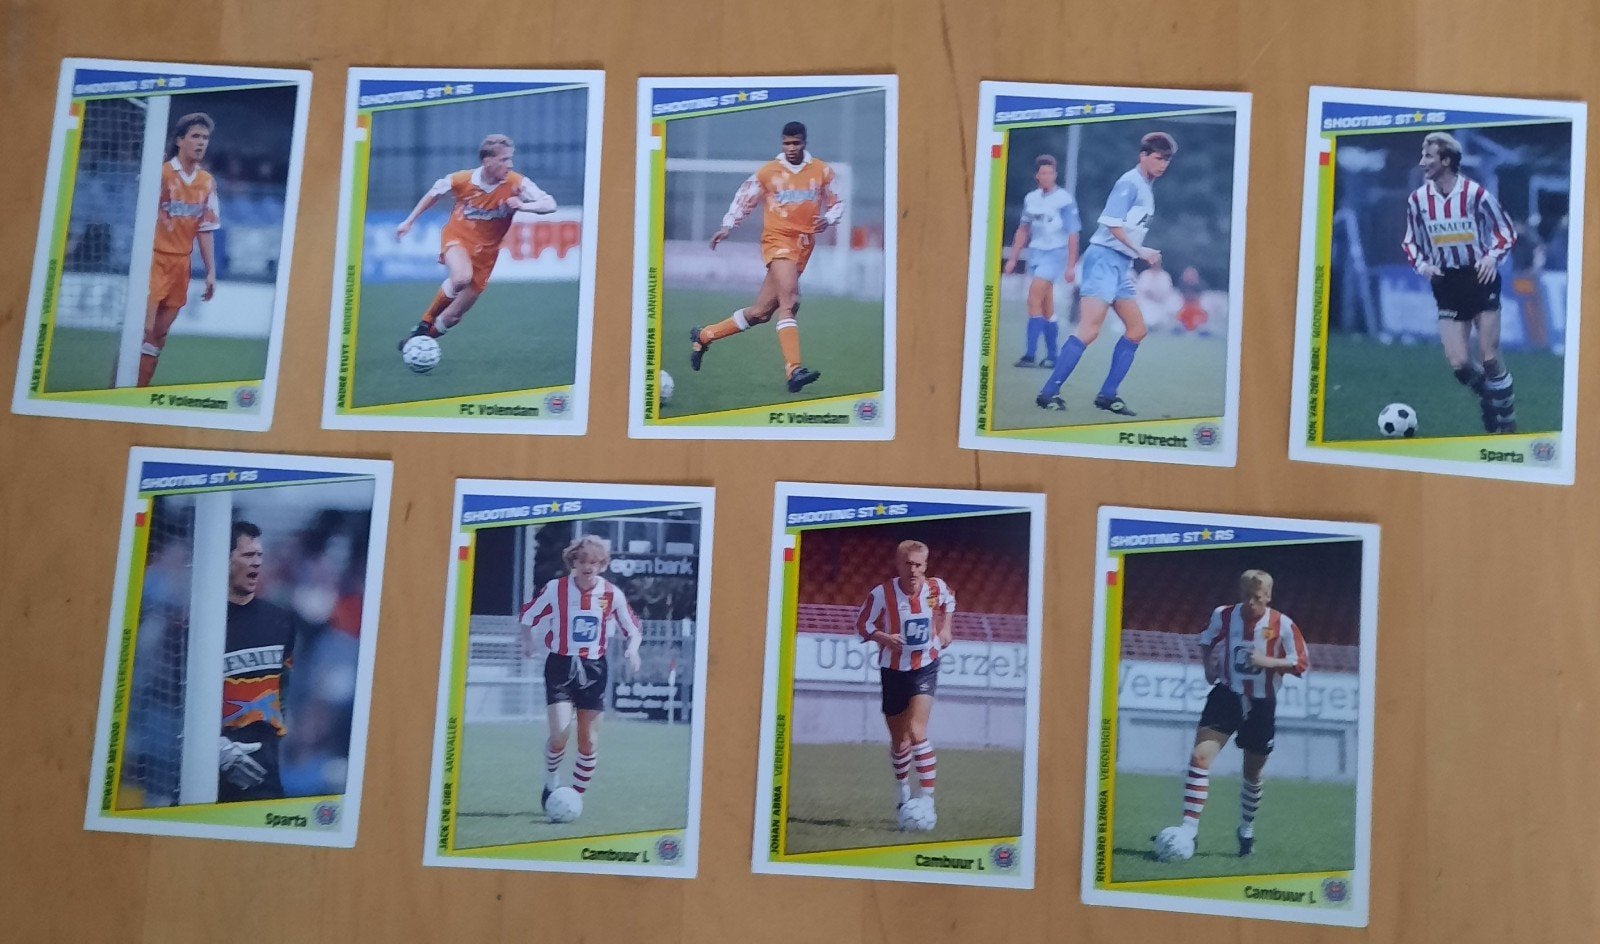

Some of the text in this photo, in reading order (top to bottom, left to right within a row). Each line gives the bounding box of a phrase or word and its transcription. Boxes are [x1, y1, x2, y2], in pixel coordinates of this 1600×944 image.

[1323, 115, 1392, 129] SHOOTING
[150, 393, 165, 405] FC
[460, 404, 475, 415] FC
[769, 412, 784, 423] FC
[1119, 432, 1188, 448] FC Utrecht
[1480, 448, 1524, 463] Sparta
[463, 506, 530, 522] SHOOTING
[1110, 532, 1180, 547] SHOOTING
[772, 786, 782, 816] ABMA
[265, 813, 307, 827] Sparta
[770, 820, 780, 855] JOHAN
[642, 850, 650, 862] L
[978, 858, 985, 870] L
[1245, 886, 1316, 904] Cambuur L
